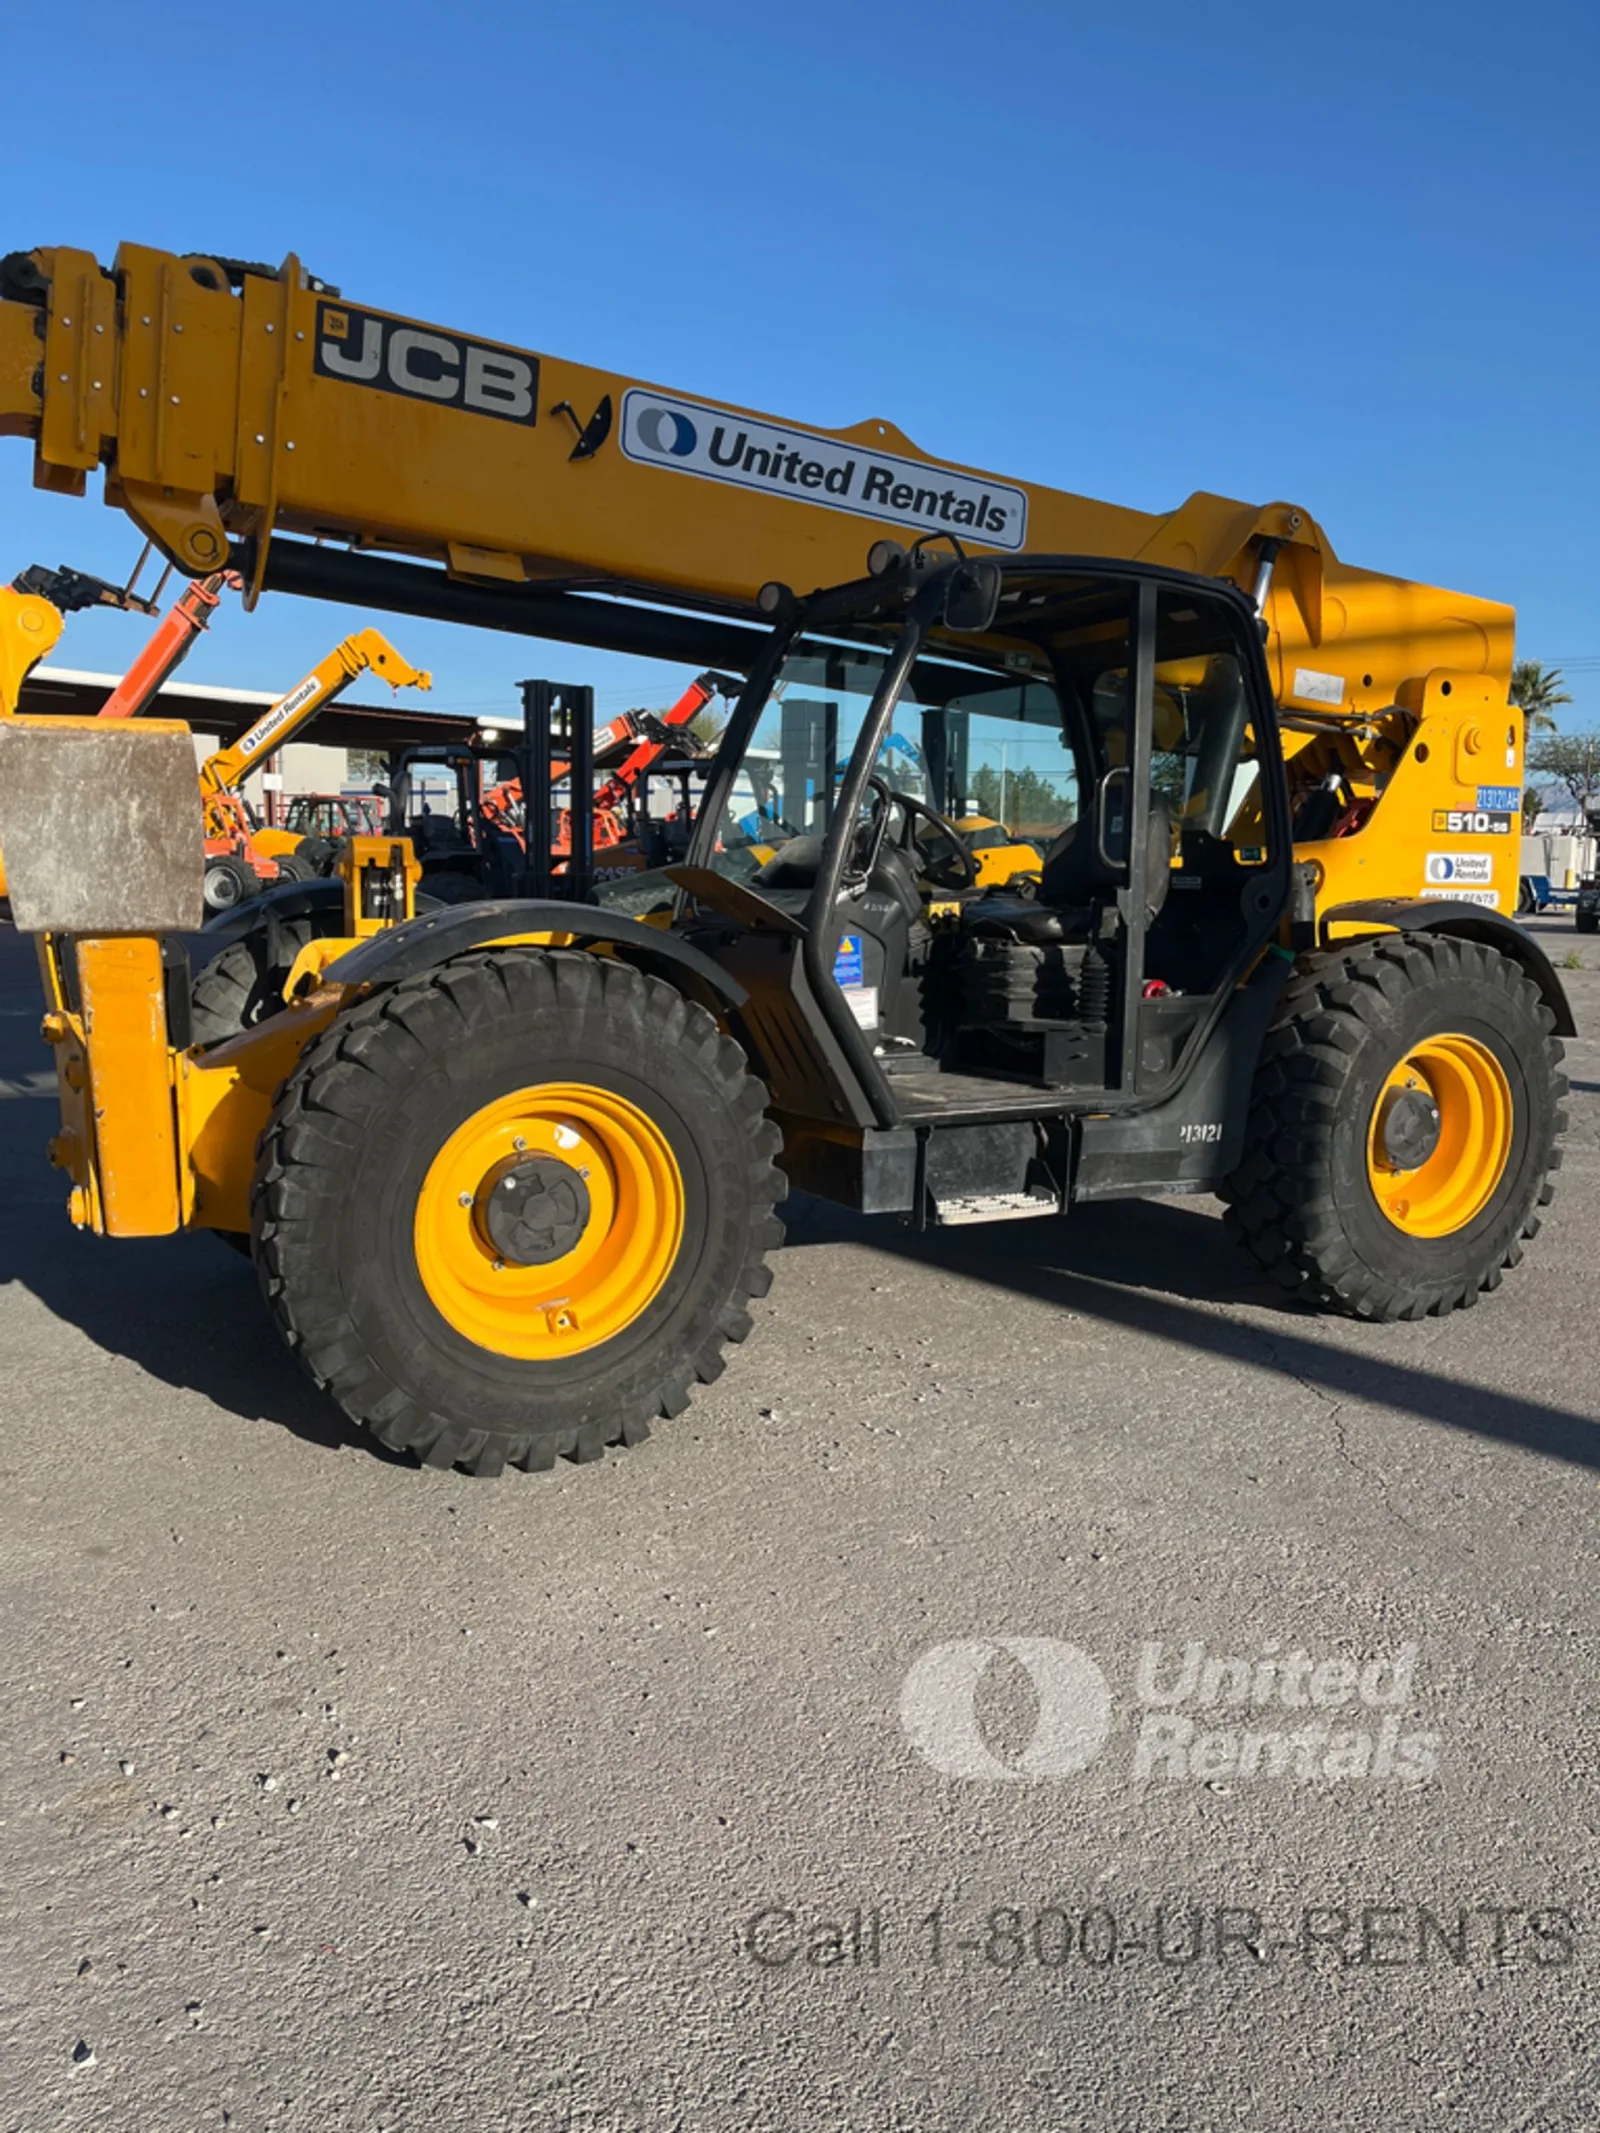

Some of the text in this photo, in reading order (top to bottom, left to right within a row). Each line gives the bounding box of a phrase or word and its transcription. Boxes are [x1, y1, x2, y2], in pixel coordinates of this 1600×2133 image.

[321, 317, 534, 419] JCB
[707, 426, 1009, 533] United Rentals
[254, 682, 316, 740] United Rentals
[593, 866, 637, 878] CASE
[1455, 857, 1488, 868] United
[1455, 868, 1489, 880] Rentals
